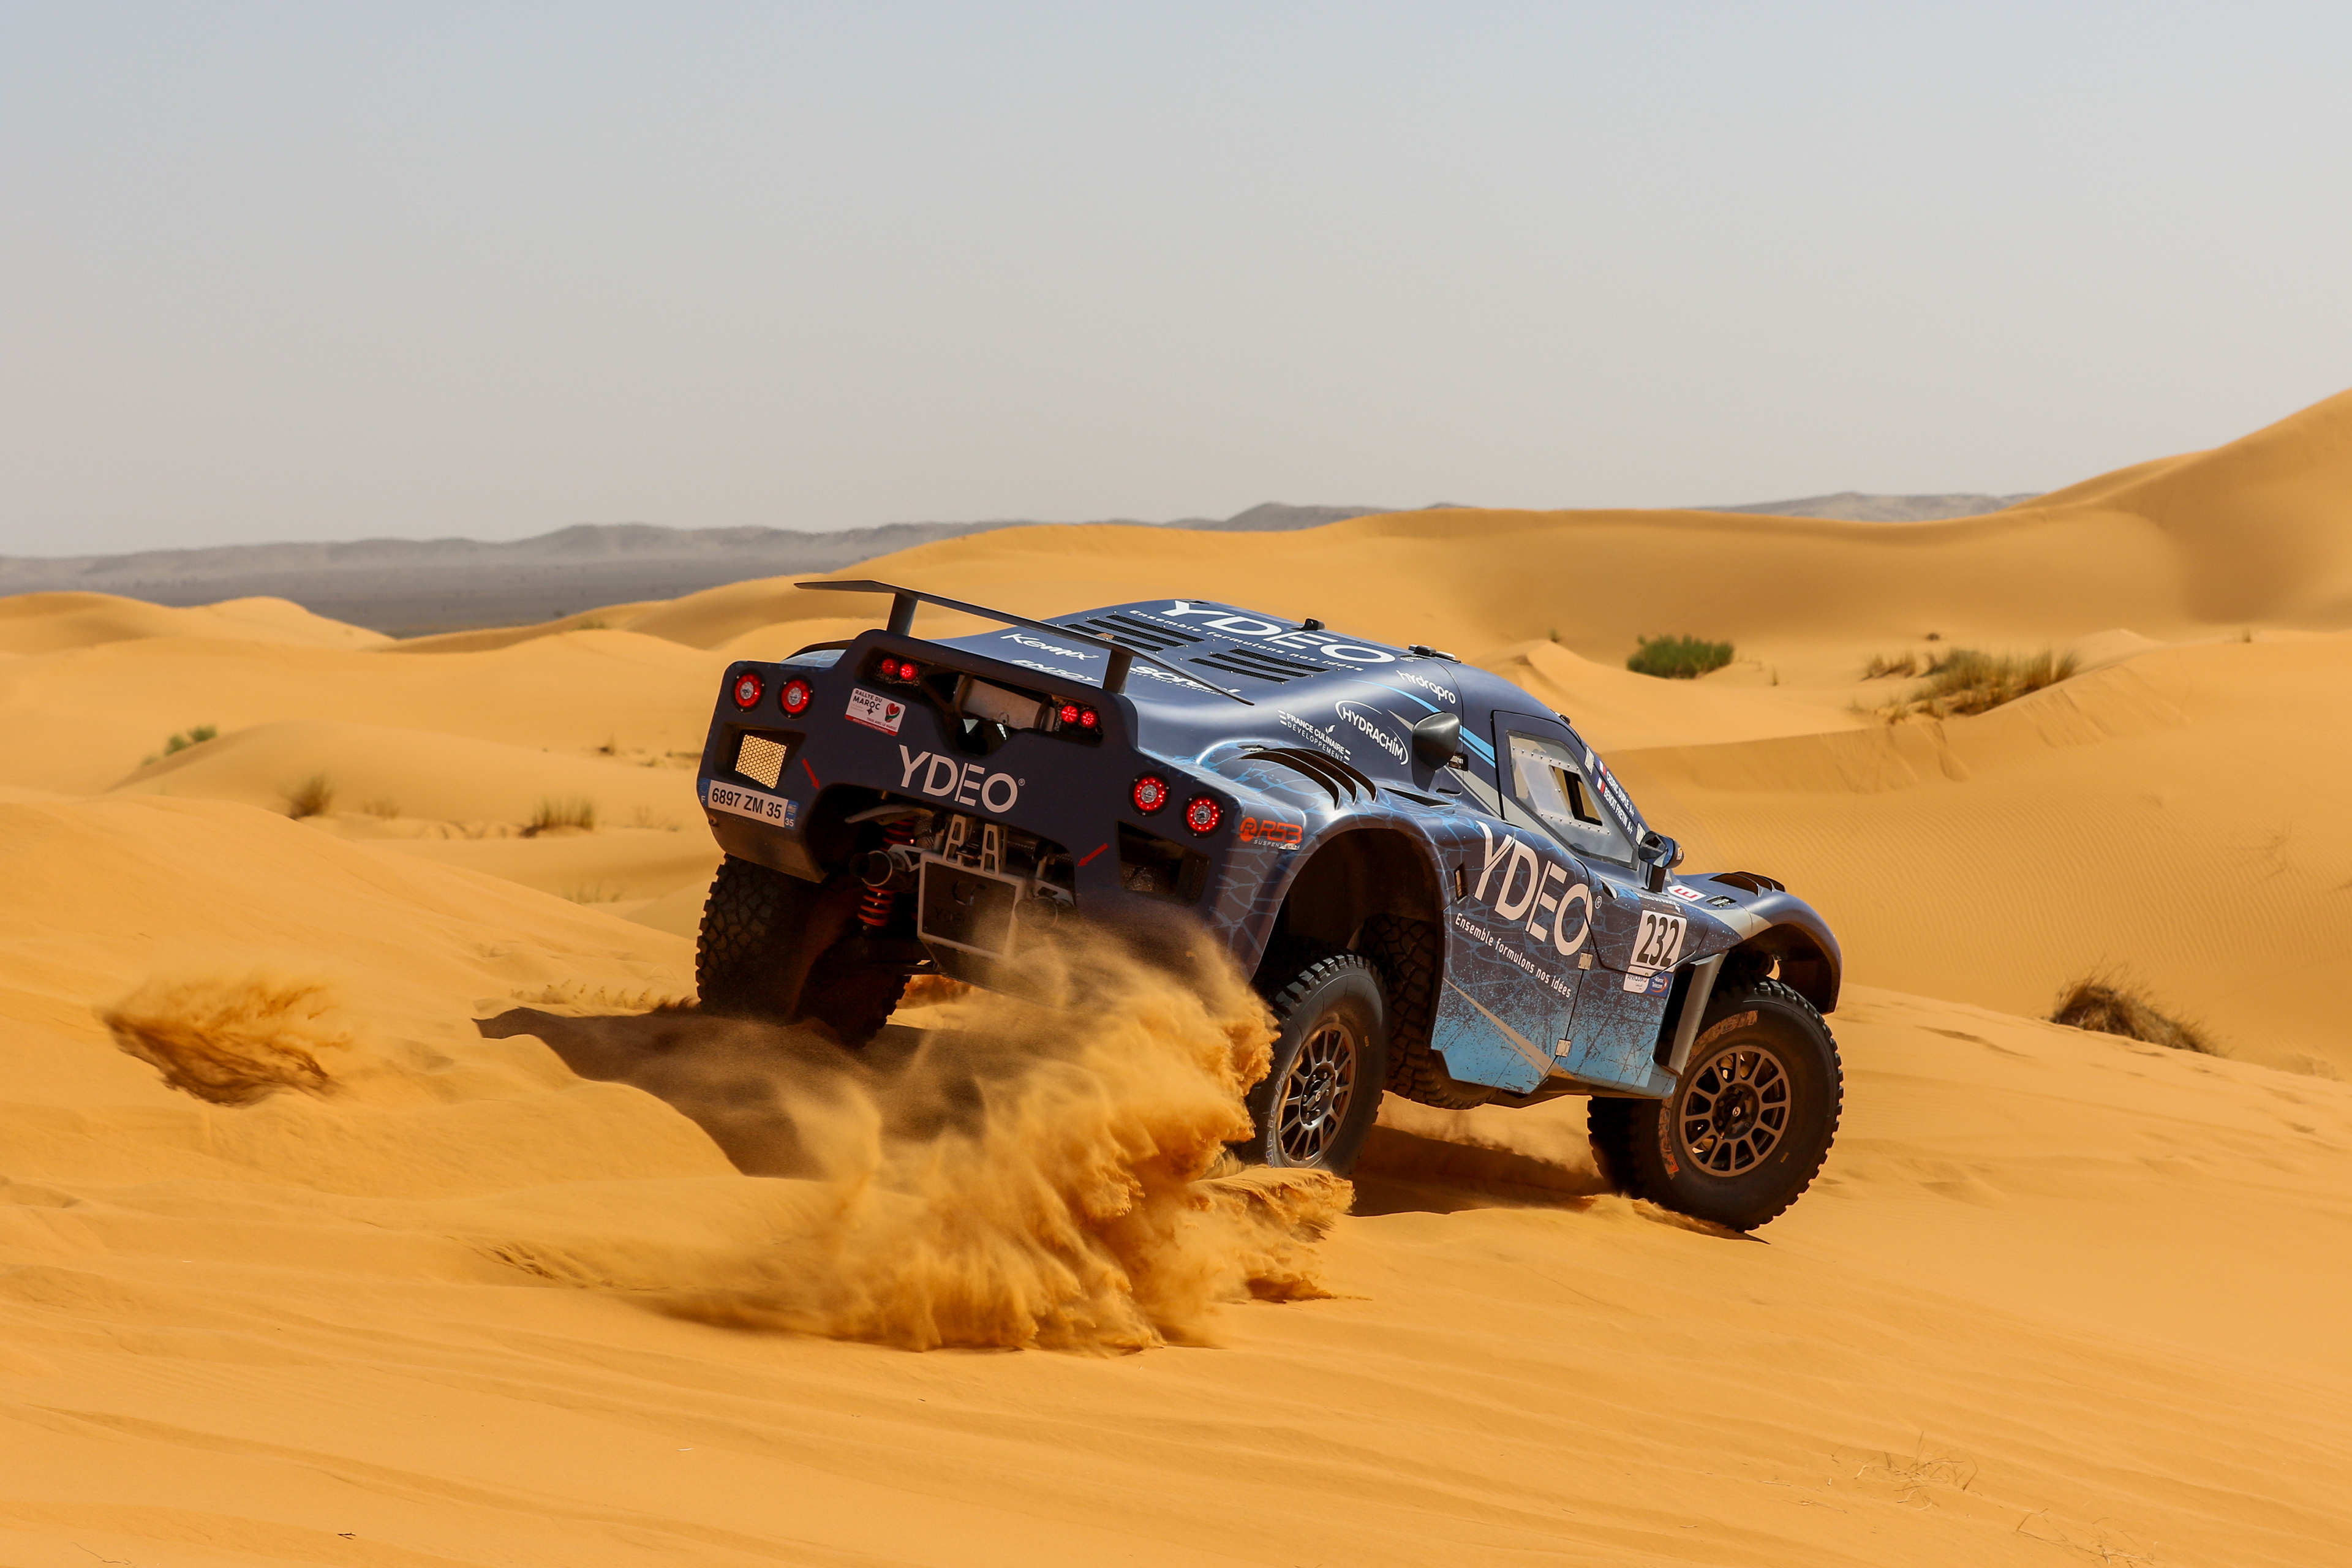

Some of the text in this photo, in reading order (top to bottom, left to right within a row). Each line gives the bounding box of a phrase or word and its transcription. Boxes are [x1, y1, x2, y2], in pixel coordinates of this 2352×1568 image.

[1000, 633, 1099, 660] Kemix
[1129, 610, 1202, 632] Ensemble
[1206, 631, 1285, 654] formulons
[1289, 652, 1317, 662] nos
[1161, 600, 1396, 663] YDEO
[1011, 659, 1101, 682] ENJOY
[853, 696, 881, 710] MAROC
[855, 690, 874, 700] RALLYE
[1287, 713, 1345, 755] FRANCE CULINAIRE
[1287, 721, 1344, 762] DÉVELOPPEMENT
[899, 744, 1018, 813] YDEO
[712, 788, 782, 819] 6897 ZM 35
[785, 818, 794, 827] 35
[1474, 820, 1593, 956] YDEO
[1455, 913, 1571, 998] Ensemble formulons nos idées
[1636, 914, 1679, 967] 232
